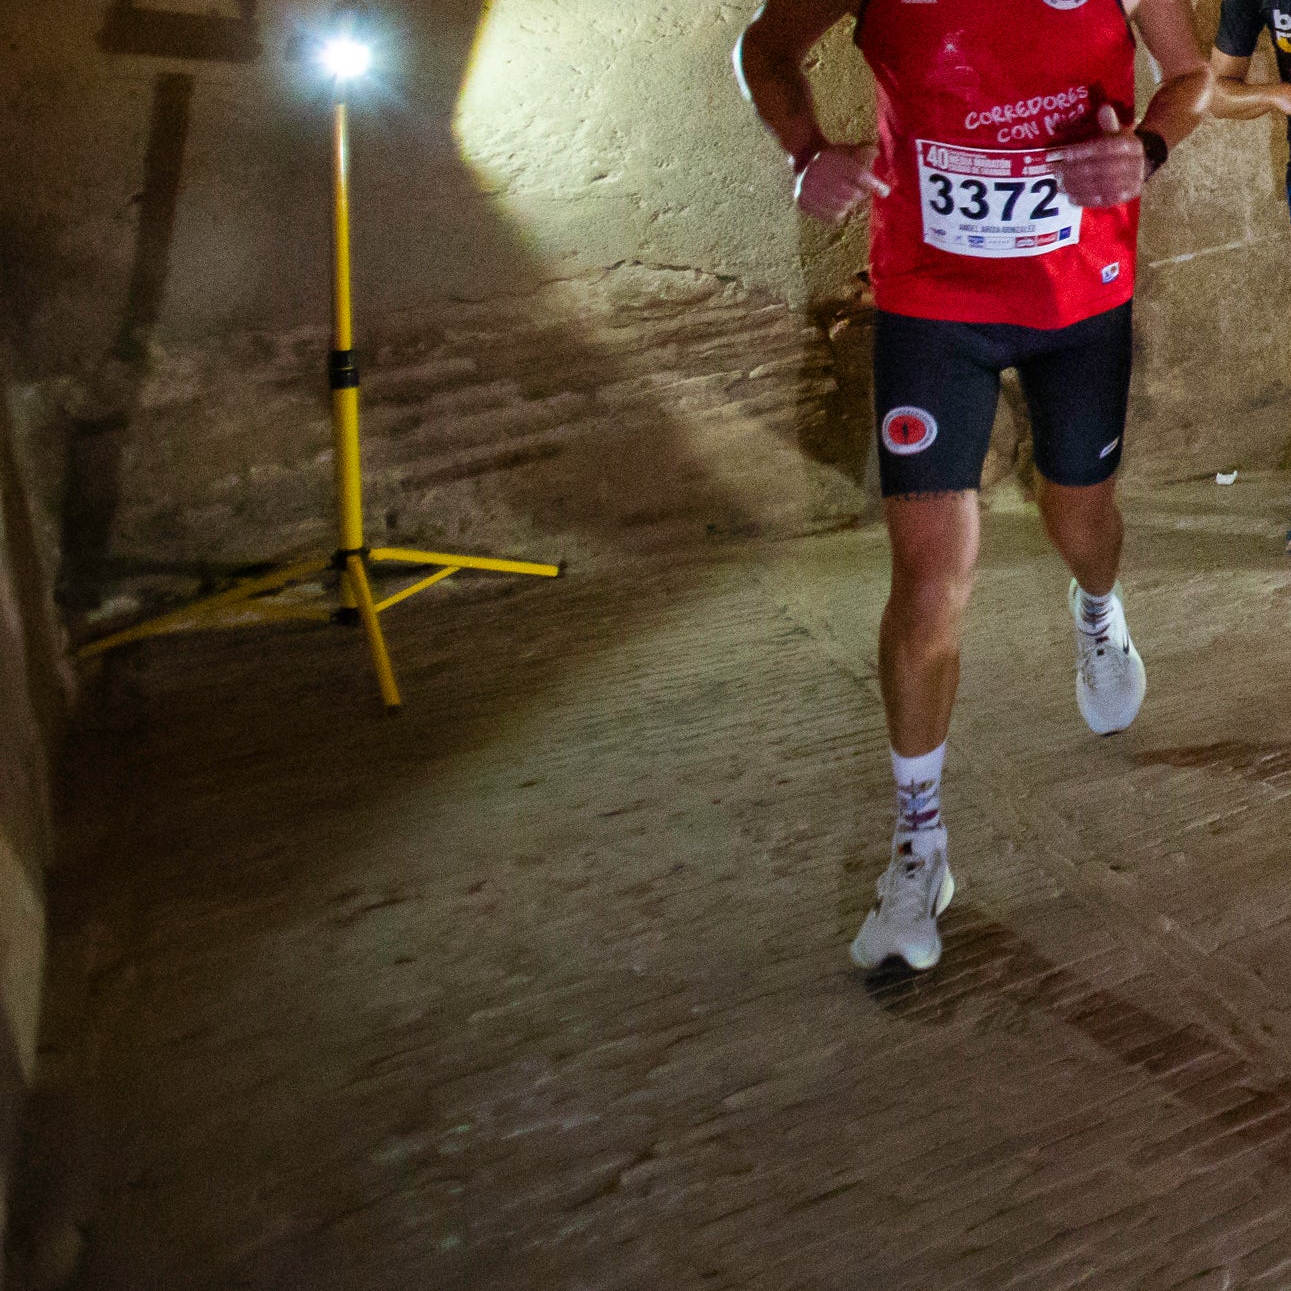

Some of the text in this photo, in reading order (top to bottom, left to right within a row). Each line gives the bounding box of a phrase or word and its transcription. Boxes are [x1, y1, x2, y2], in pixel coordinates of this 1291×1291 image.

[964, 85, 1089, 130] CORREDORES
[996, 120, 1040, 143] CON
[927, 144, 949, 170] 40
[928, 173, 1060, 221] 3372
